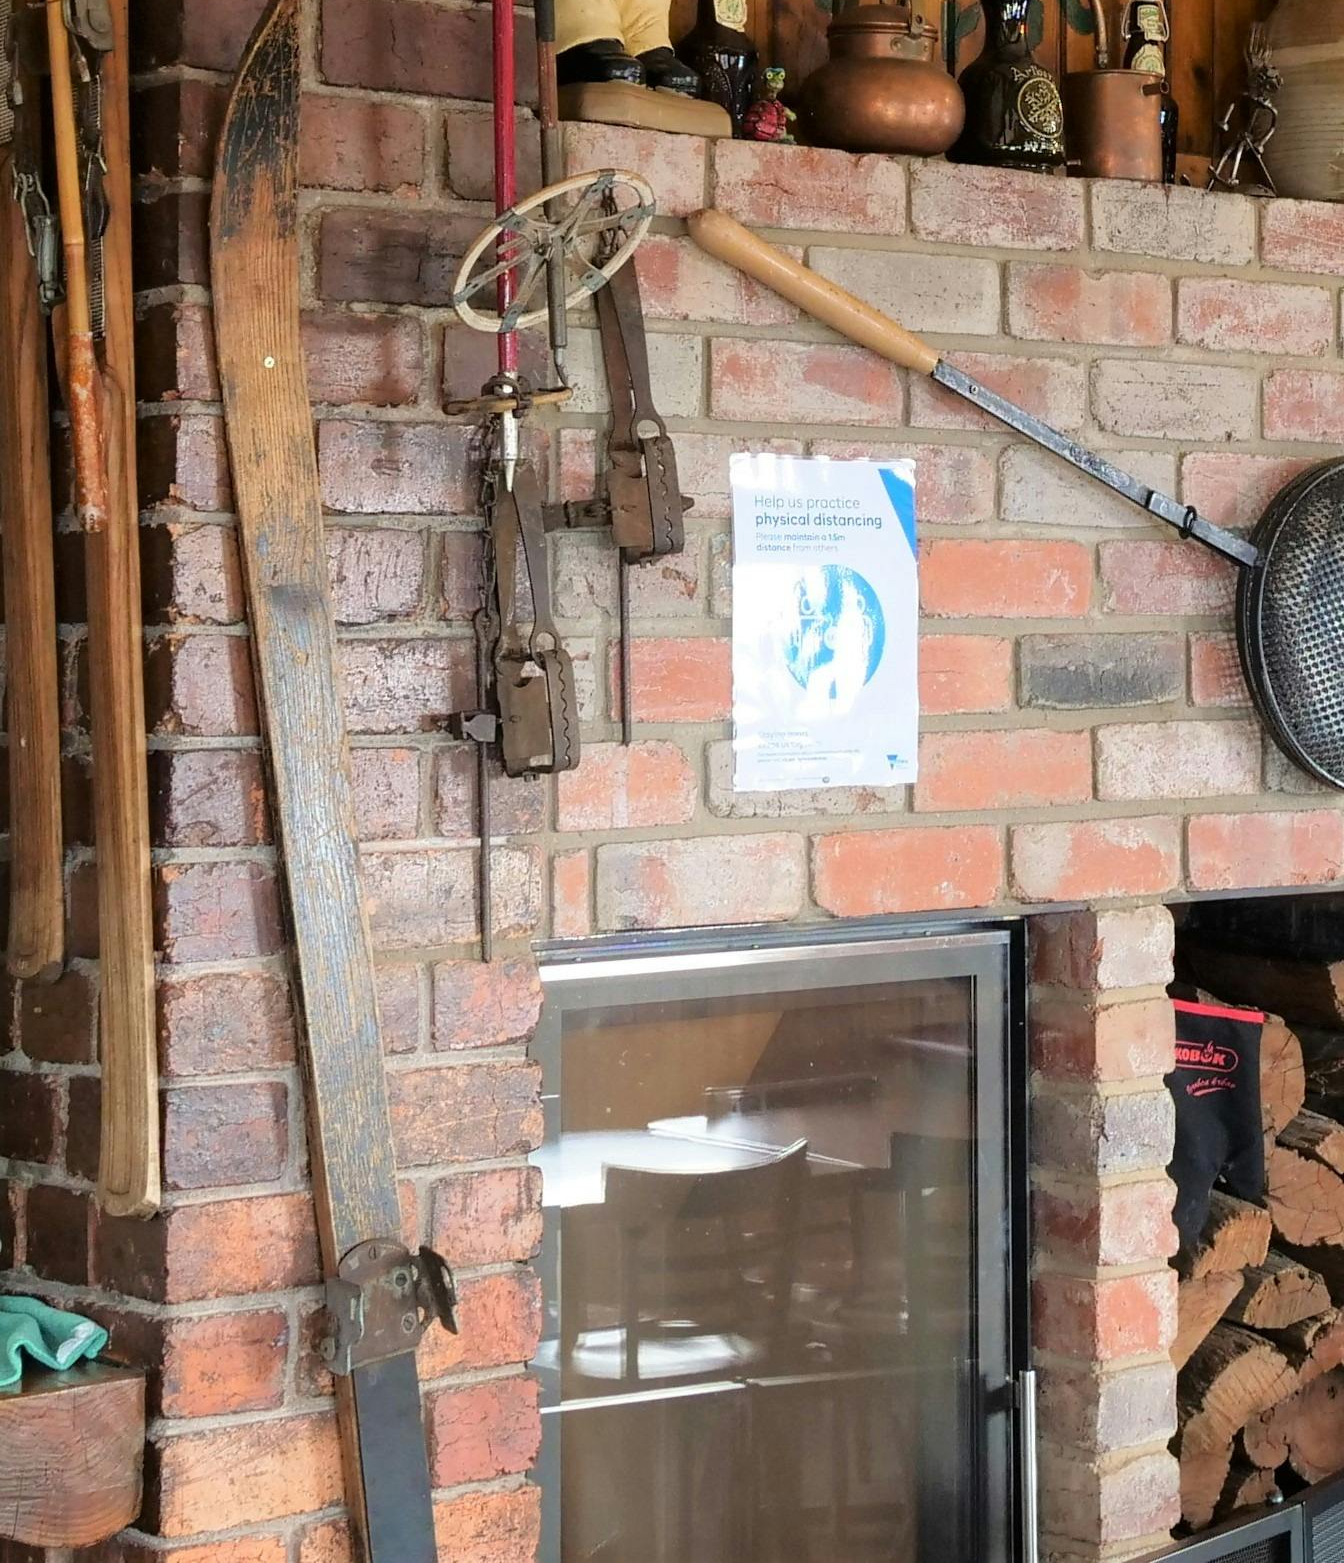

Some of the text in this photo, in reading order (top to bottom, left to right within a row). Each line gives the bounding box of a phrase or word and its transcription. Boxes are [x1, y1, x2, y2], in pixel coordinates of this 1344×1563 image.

[754, 494, 860, 511] Help us practice
[755, 512, 882, 529] physical distancing
